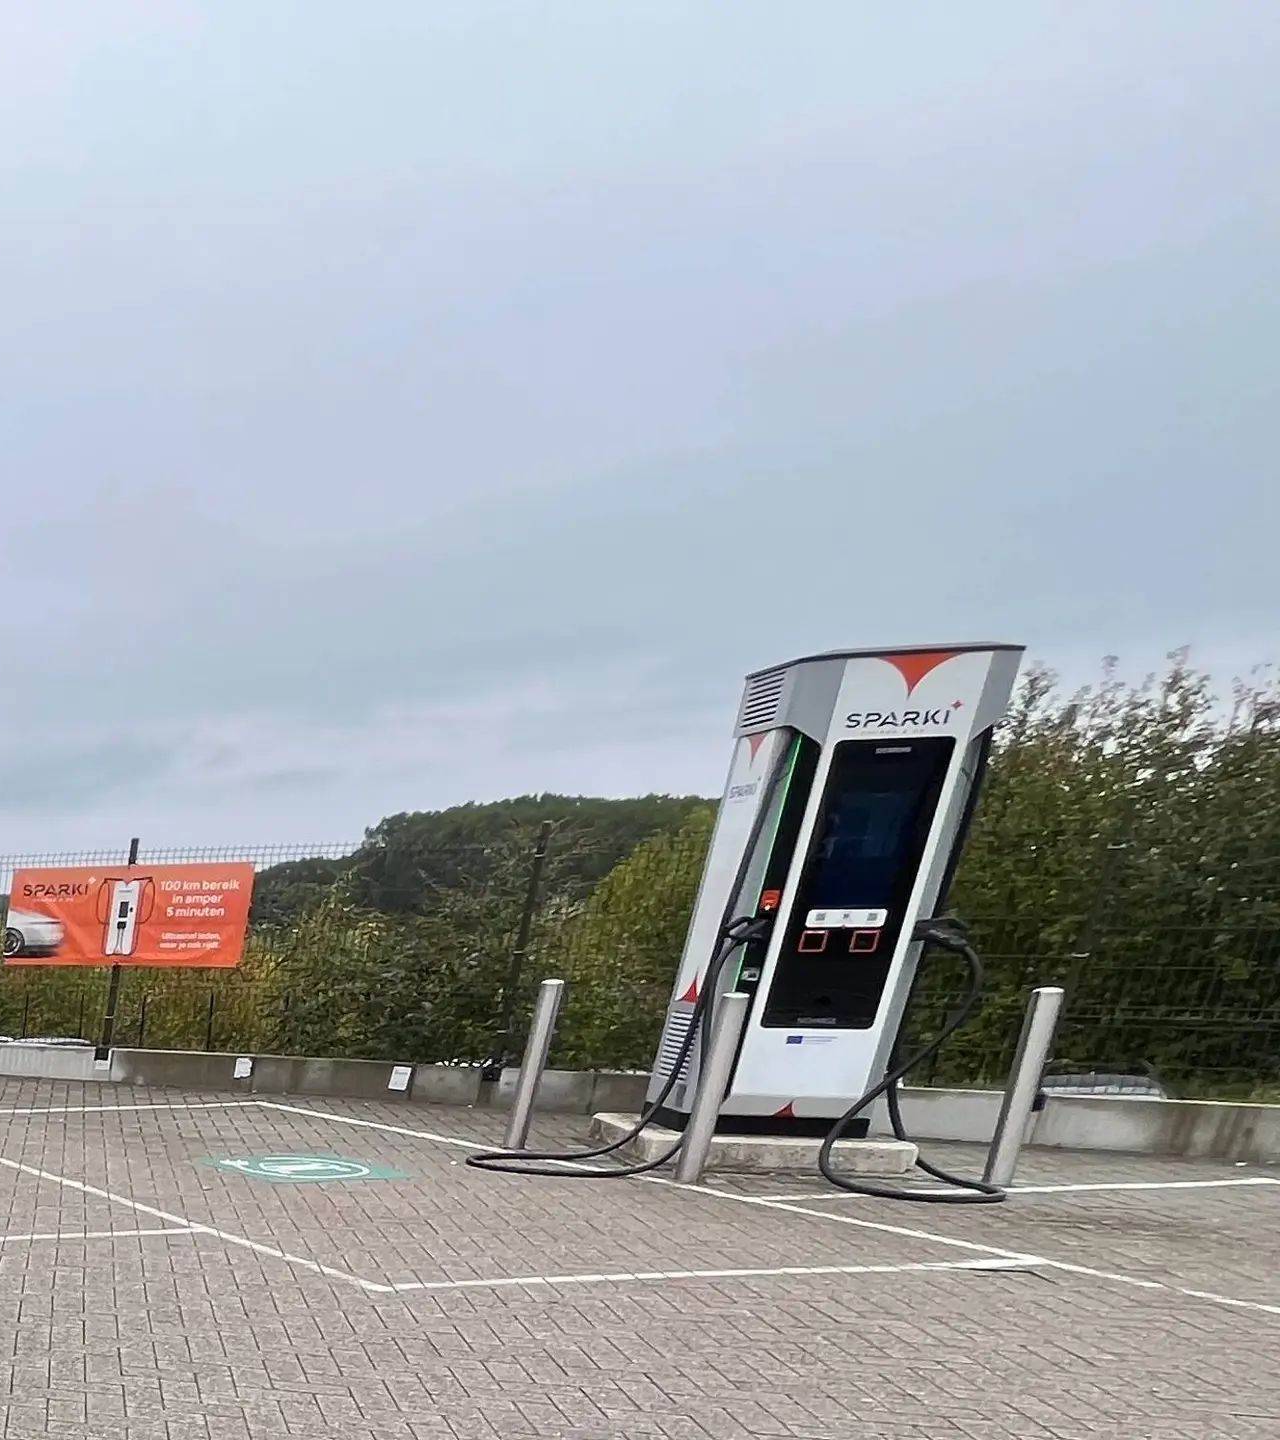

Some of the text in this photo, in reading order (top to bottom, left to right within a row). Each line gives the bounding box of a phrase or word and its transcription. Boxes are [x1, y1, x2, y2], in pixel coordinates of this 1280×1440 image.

[845, 709, 951, 728] SPARKI
[23, 883, 89, 897] SPARKI
[160, 879, 240, 891] 100 km bereik
[172, 894, 224, 906] in amper
[175, 906, 225, 917] minuten
